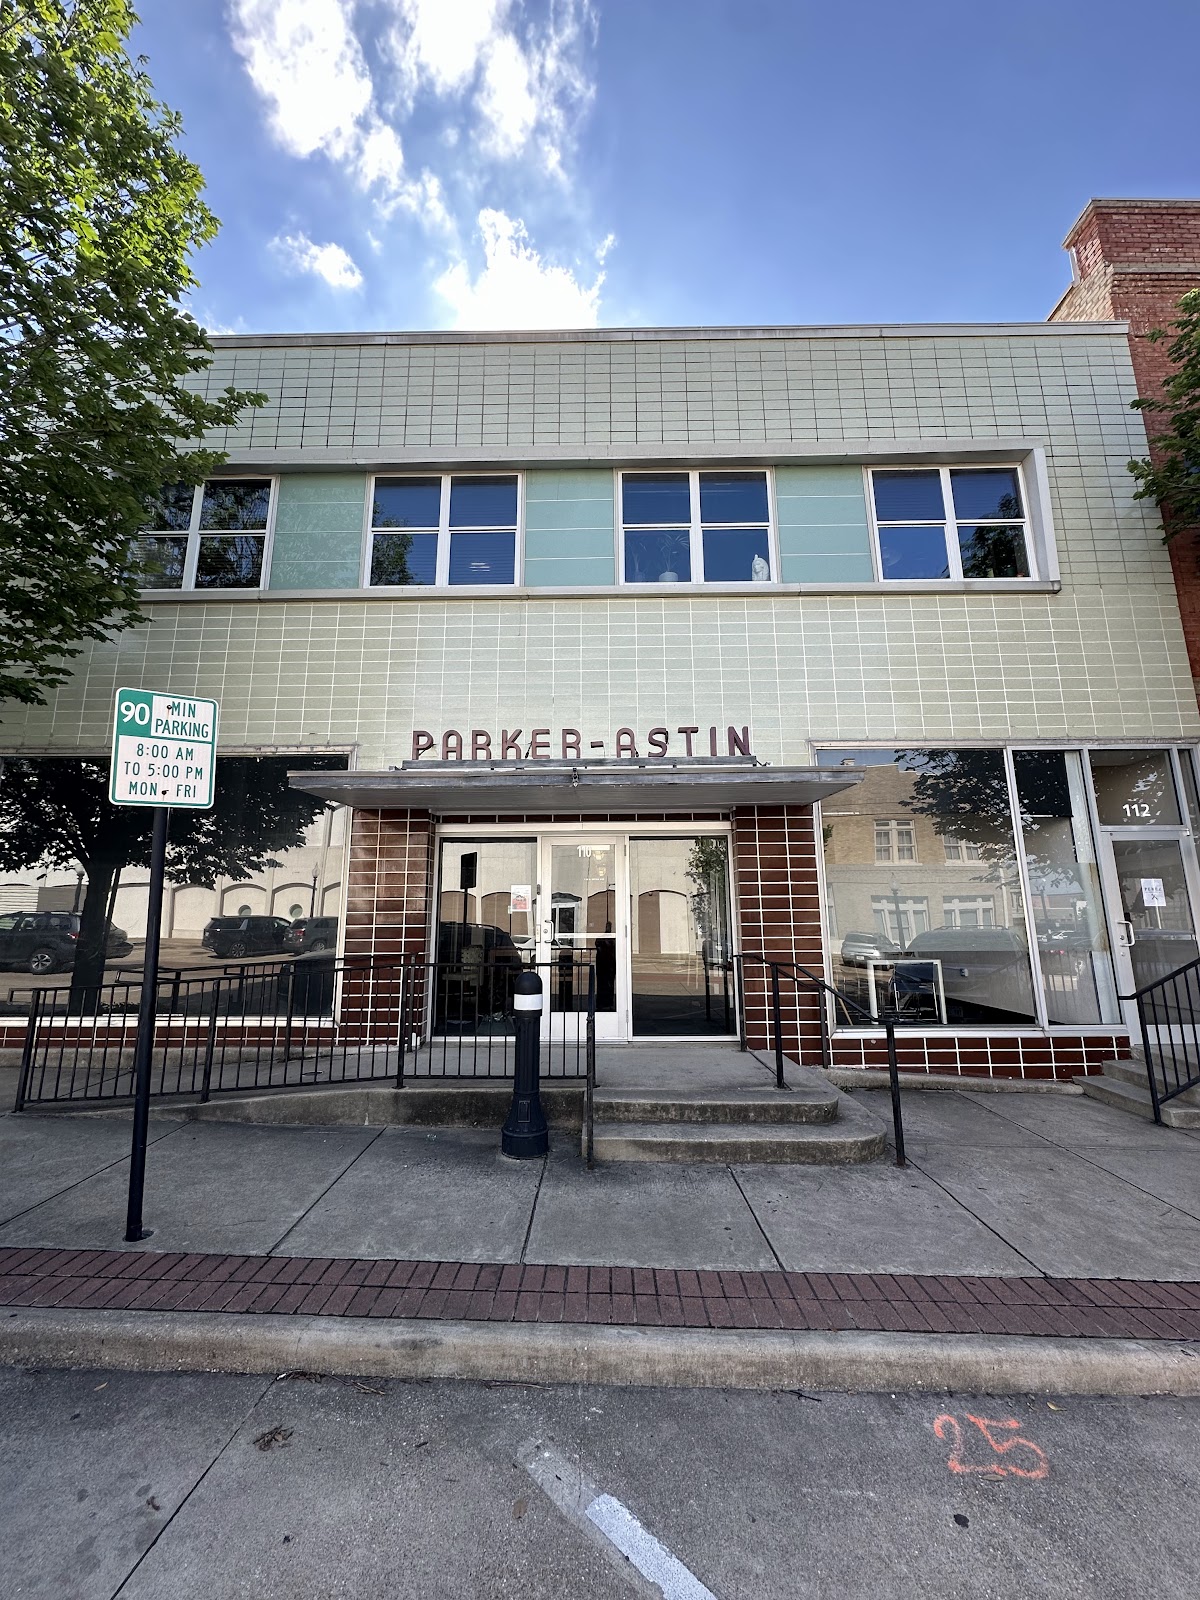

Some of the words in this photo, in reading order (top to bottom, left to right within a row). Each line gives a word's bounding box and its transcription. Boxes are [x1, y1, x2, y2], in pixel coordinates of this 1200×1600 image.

[120, 701, 150, 725] 90
[171, 701, 196, 718] MIN
[155, 718, 209, 738] PARKING
[136, 743, 169, 758] 8:00
[175, 747, 193, 760] AM
[412, 726, 752, 760] PARKER-ASTIN
[124, 761, 140, 775] TO
[148, 763, 179, 778] 5:00
[186, 766, 203, 780] PM
[129, 781, 157, 795] MON
[176, 784, 196, 798] FRI
[1123, 803, 1151, 817] 112
[576, 845, 592, 857] 110
[933, 1413, 1050, 1479] 25
